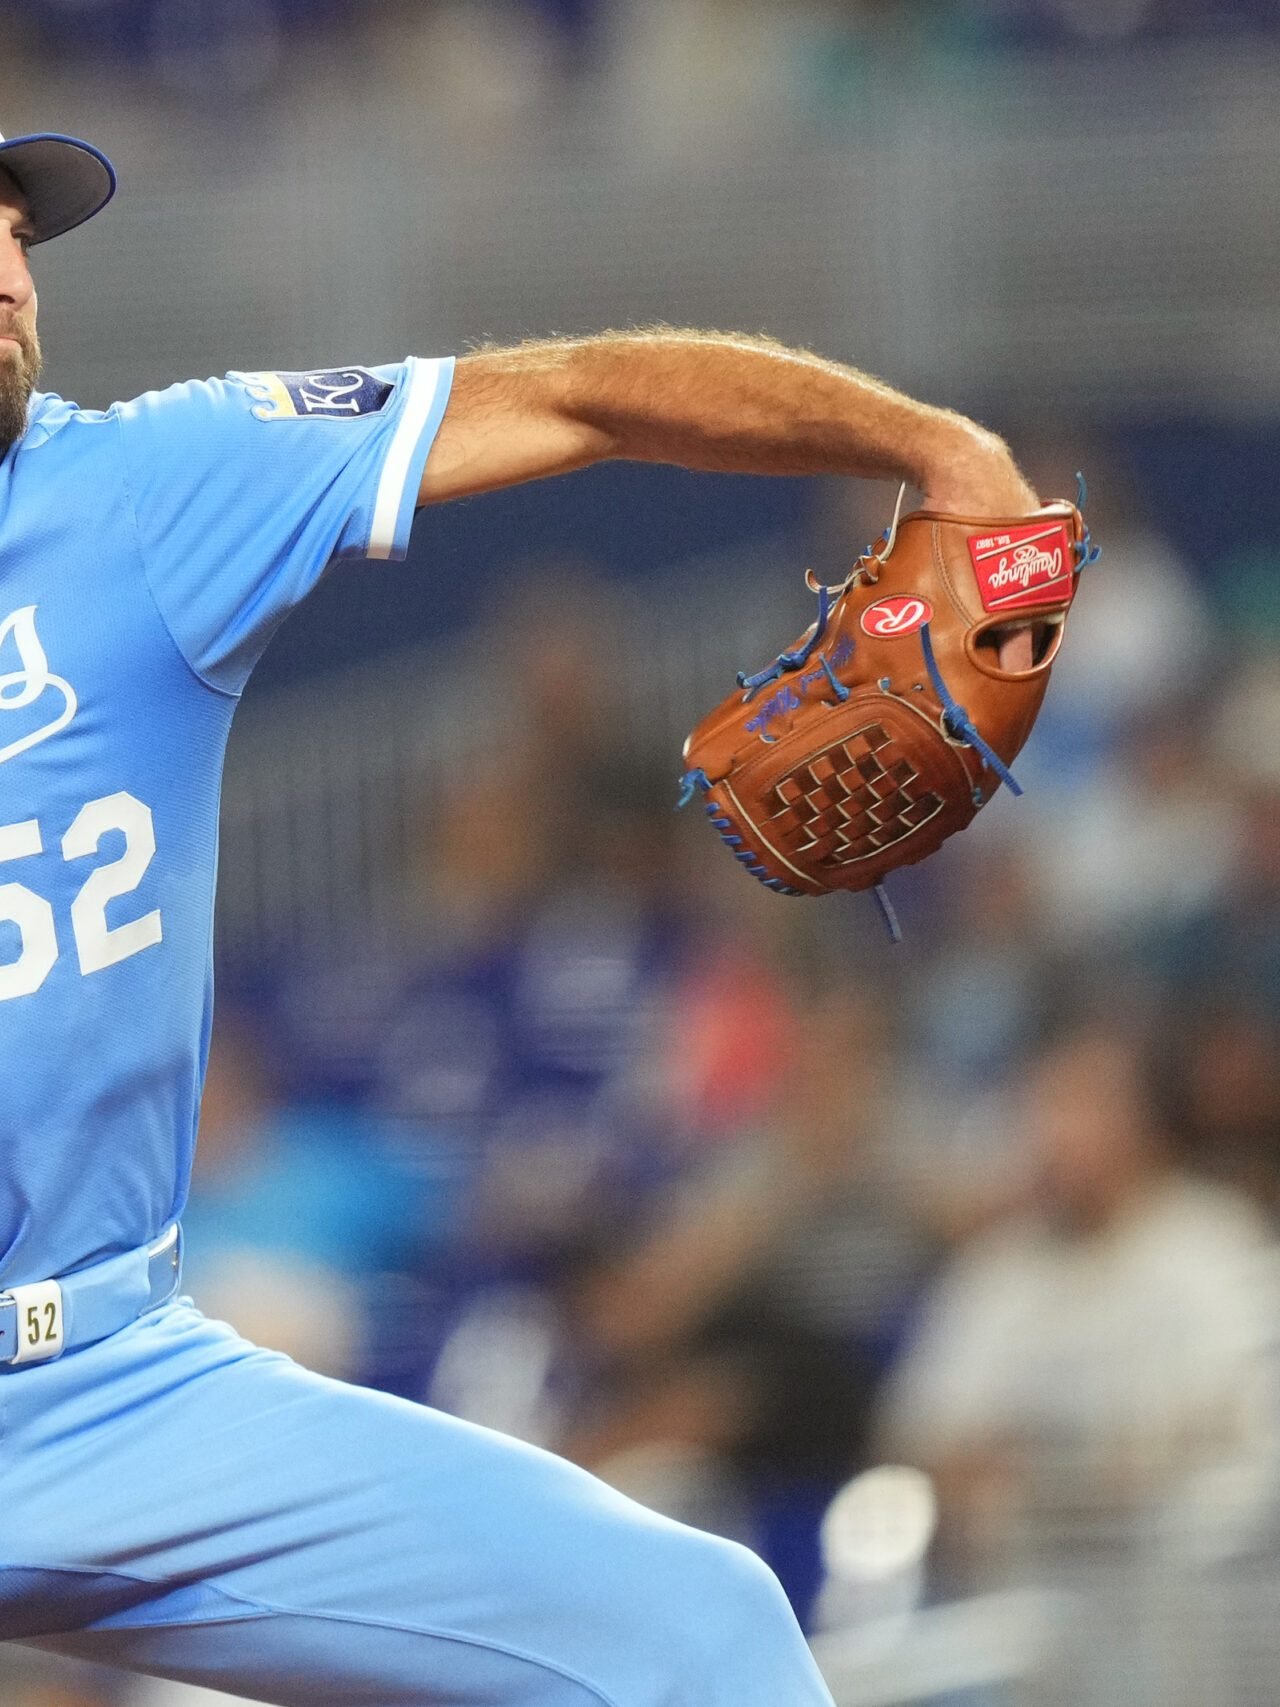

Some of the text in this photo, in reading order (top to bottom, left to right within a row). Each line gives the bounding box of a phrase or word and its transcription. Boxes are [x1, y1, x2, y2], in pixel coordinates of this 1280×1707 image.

[298, 373, 364, 413] KC
[988, 547, 1062, 589] Rawlings
[872, 600, 924, 633] R
[27, 1302, 57, 1345] 52
